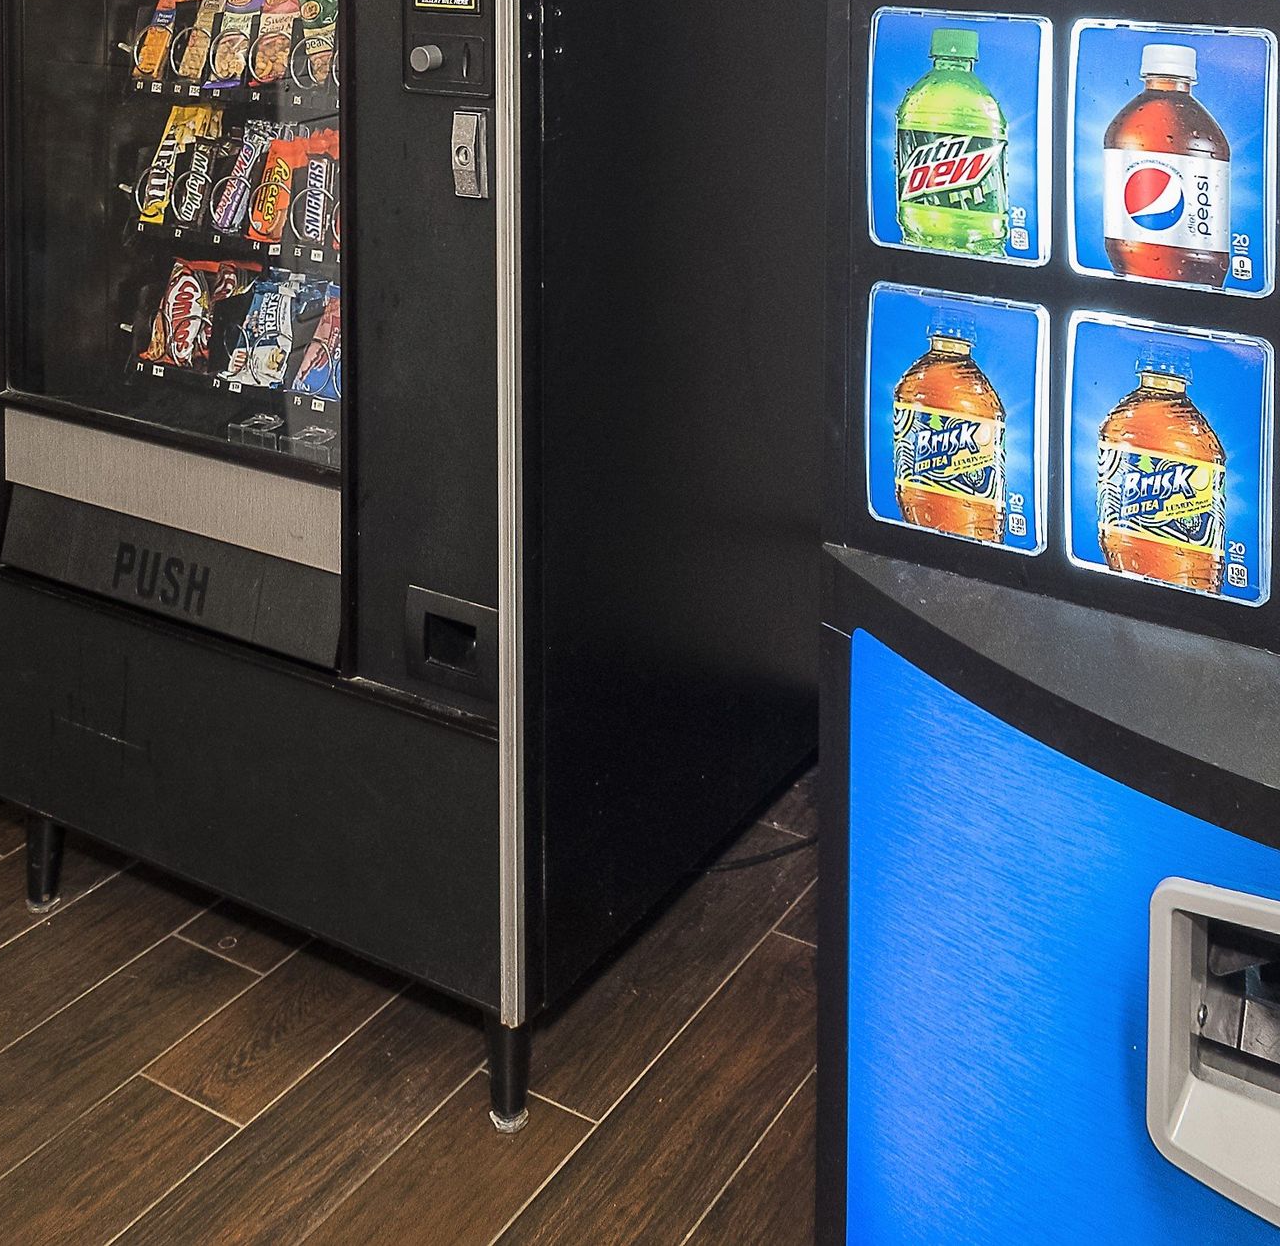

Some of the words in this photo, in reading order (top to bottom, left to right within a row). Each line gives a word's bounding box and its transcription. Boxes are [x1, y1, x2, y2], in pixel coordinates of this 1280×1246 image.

[305, 160, 325, 242] SNICKERS
[1194, 175, 1212, 236] pepsi
[1187, 213, 1197, 234] diet
[1232, 233, 1250, 247] 20
[265, 293, 280, 340] TREATS
[932, 456, 948, 467] TEA
[1009, 492, 1024, 506] 20
[1141, 500, 1159, 511] TEA
[1011, 516, 1024, 526] 130
[1228, 541, 1246, 555] 20
[112, 542, 211, 616] PUSH
[1230, 566, 1245, 578] 130
